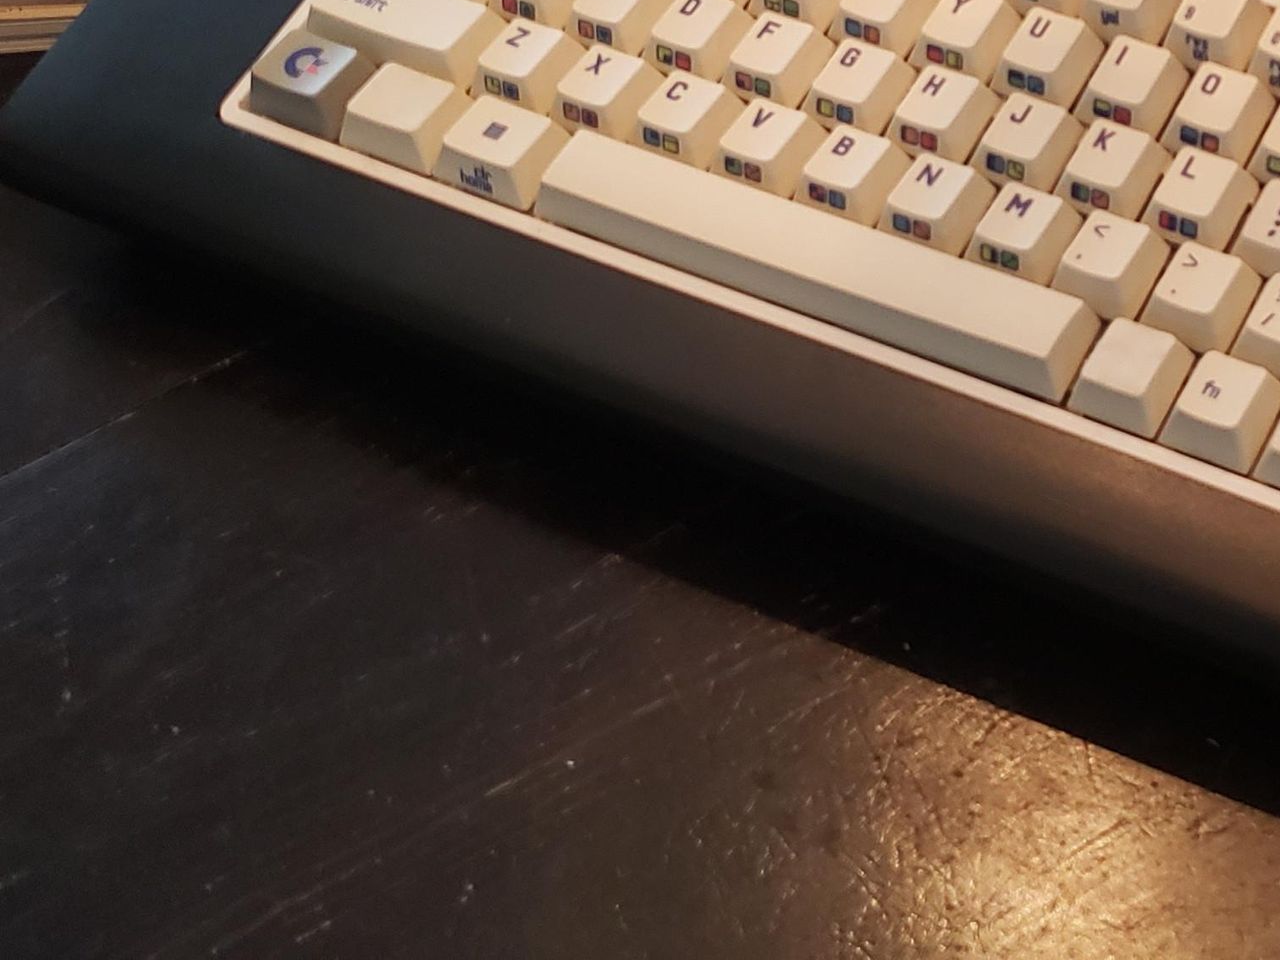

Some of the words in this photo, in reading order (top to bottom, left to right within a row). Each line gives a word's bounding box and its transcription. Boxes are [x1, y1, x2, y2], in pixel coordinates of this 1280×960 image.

[505, 28, 531, 47] Z
[756, 20, 781, 40] F
[1030, 17, 1051, 38] U
[585, 55, 612, 76] X
[839, 47, 861, 68] G
[666, 81, 688, 101] C
[921, 74, 946, 96] H
[752, 108, 773, 128] V
[1010, 104, 1033, 124] J
[831, 136, 855, 156] B
[1092, 130, 1119, 152] K
[915, 164, 944, 187] N
[1180, 157, 1196, 179] L
[1004, 193, 1035, 218] M
[1201, 380, 1222, 400] fn
